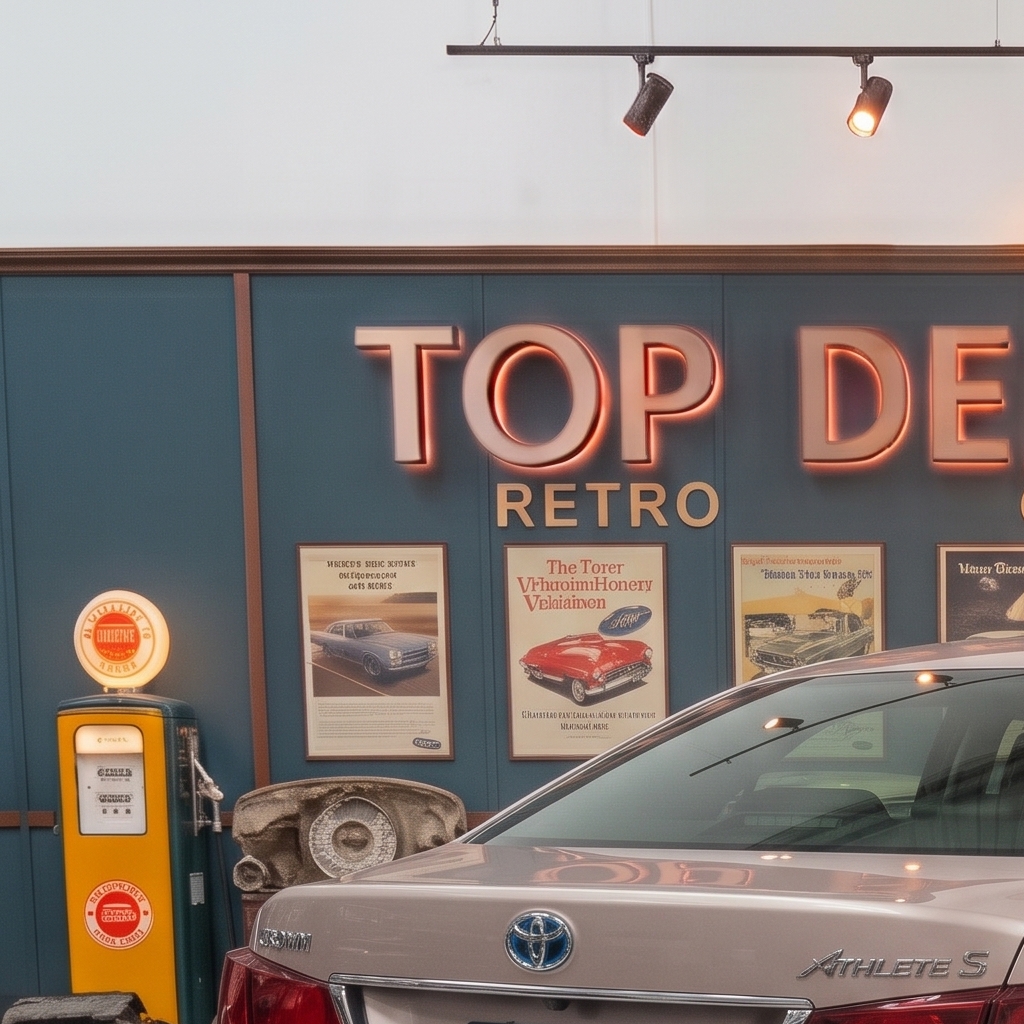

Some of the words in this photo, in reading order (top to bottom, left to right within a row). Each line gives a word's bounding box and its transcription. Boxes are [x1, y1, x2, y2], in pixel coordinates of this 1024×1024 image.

[354, 323, 720, 468] TOP
[496, 481, 720, 528] RETRO
[547, 559, 577, 575] The
[797, 949, 952, 978] ATHLETE
[957, 950, 990, 977] S
